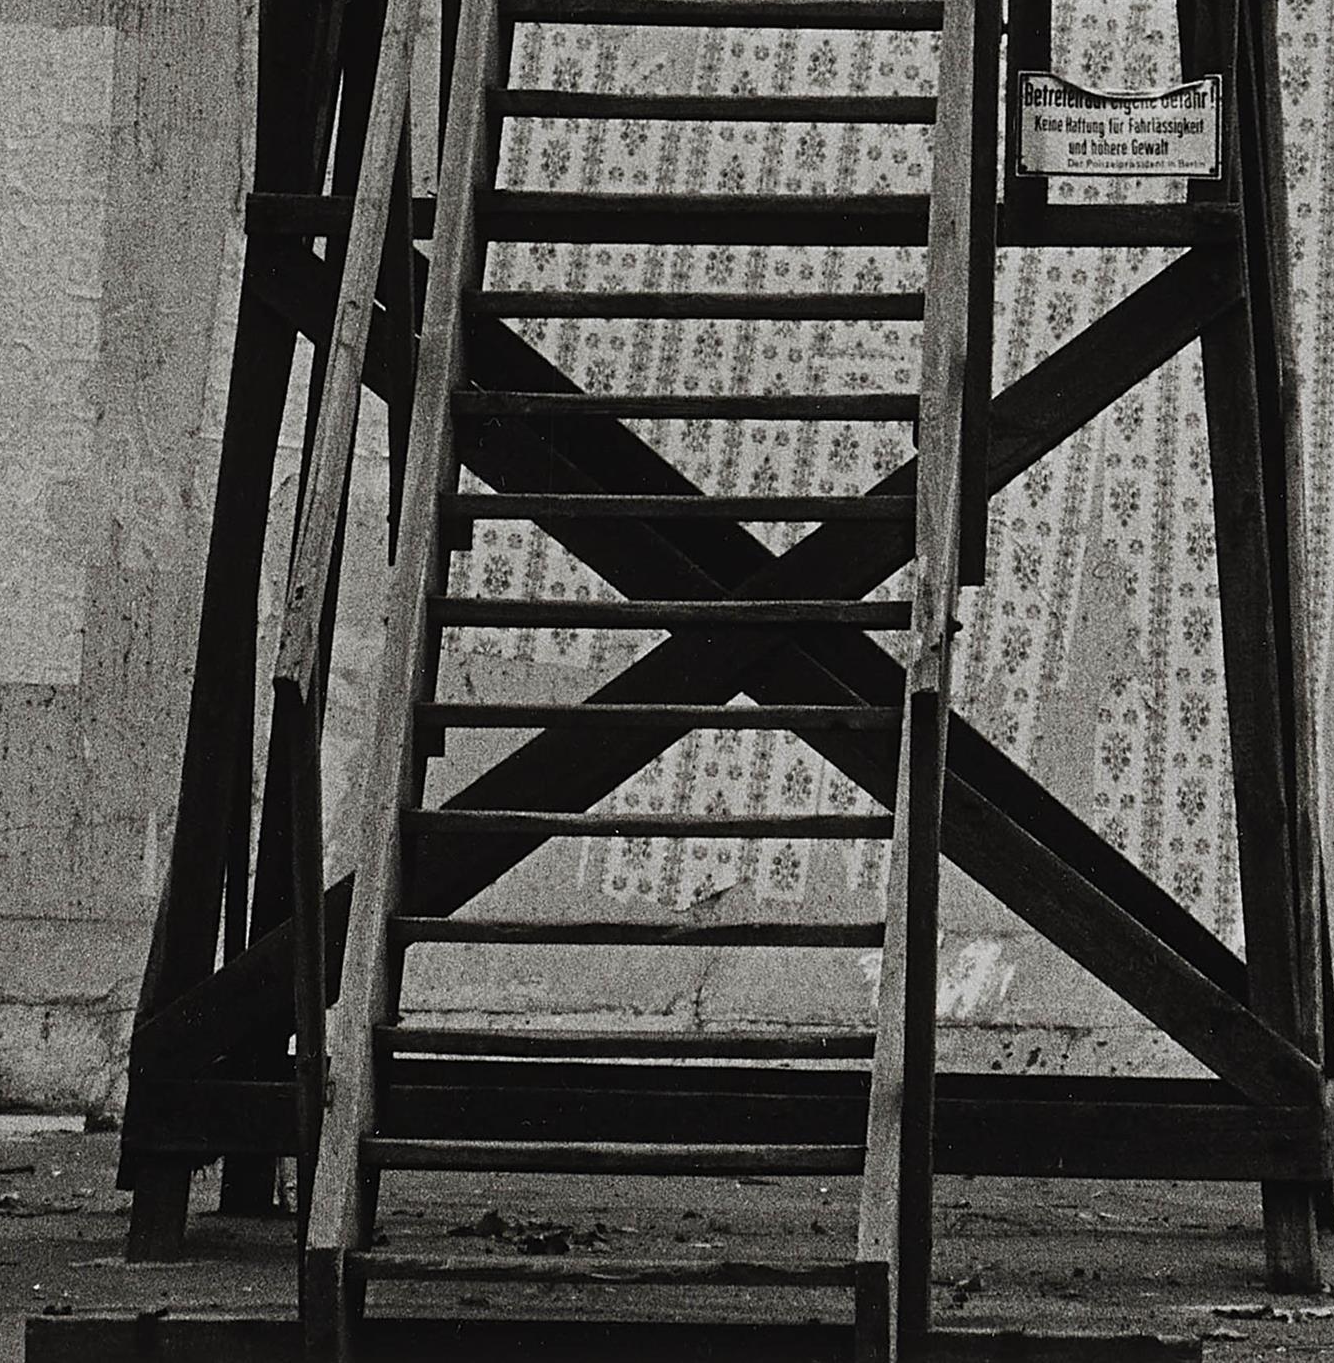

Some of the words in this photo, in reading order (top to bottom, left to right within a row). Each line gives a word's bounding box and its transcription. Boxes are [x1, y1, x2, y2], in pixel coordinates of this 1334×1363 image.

[1034, 115, 1063, 132] Keine
[1065, 116, 1105, 138] Haftung
[1108, 117, 1124, 134] für
[1128, 117, 1204, 138] Fahrlässigkeit
[1068, 139, 1087, 156] und
[1090, 139, 1128, 156] höhere
[1131, 138, 1169, 156] Gewalt
[1067, 158, 1084, 168] Der
[1177, 160, 1206, 169] Berlin
